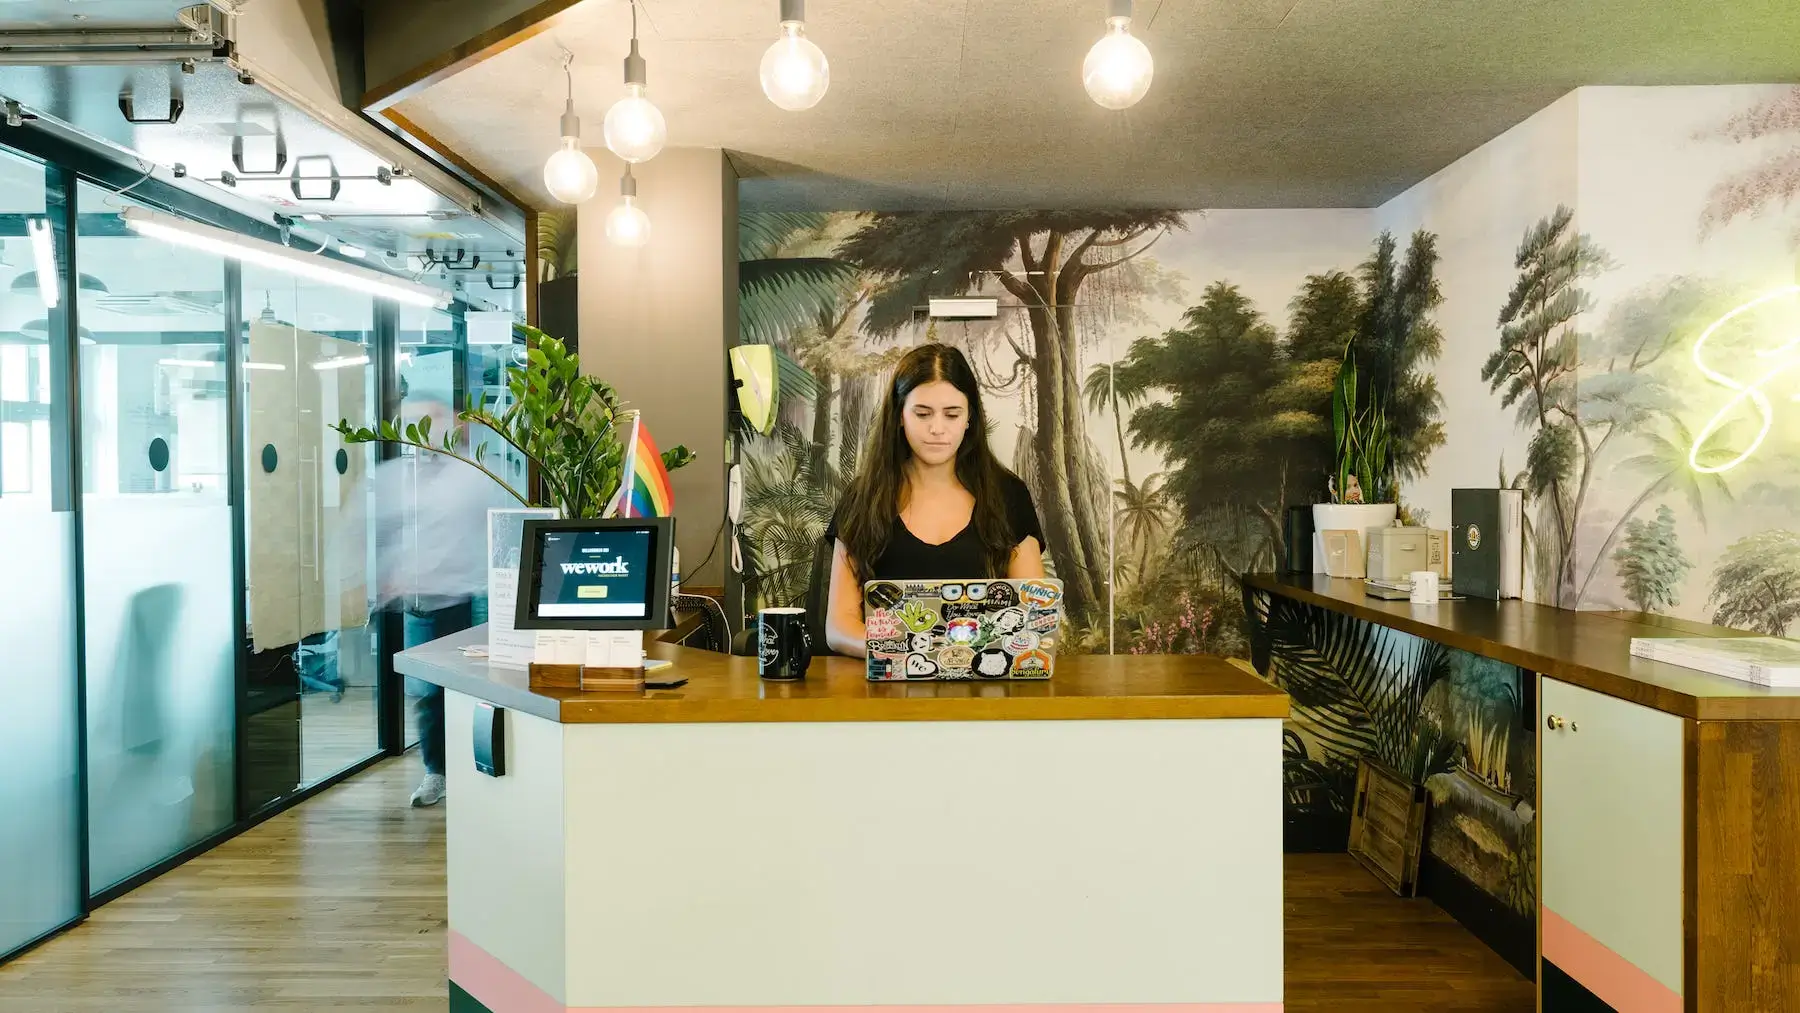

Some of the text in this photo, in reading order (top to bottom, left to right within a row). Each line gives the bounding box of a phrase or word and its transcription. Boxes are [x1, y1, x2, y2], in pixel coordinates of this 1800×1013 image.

[560, 555, 629, 574] wework
[1020, 583, 1062, 600] MUNICH
[1030, 615, 1056, 627] LONDON
